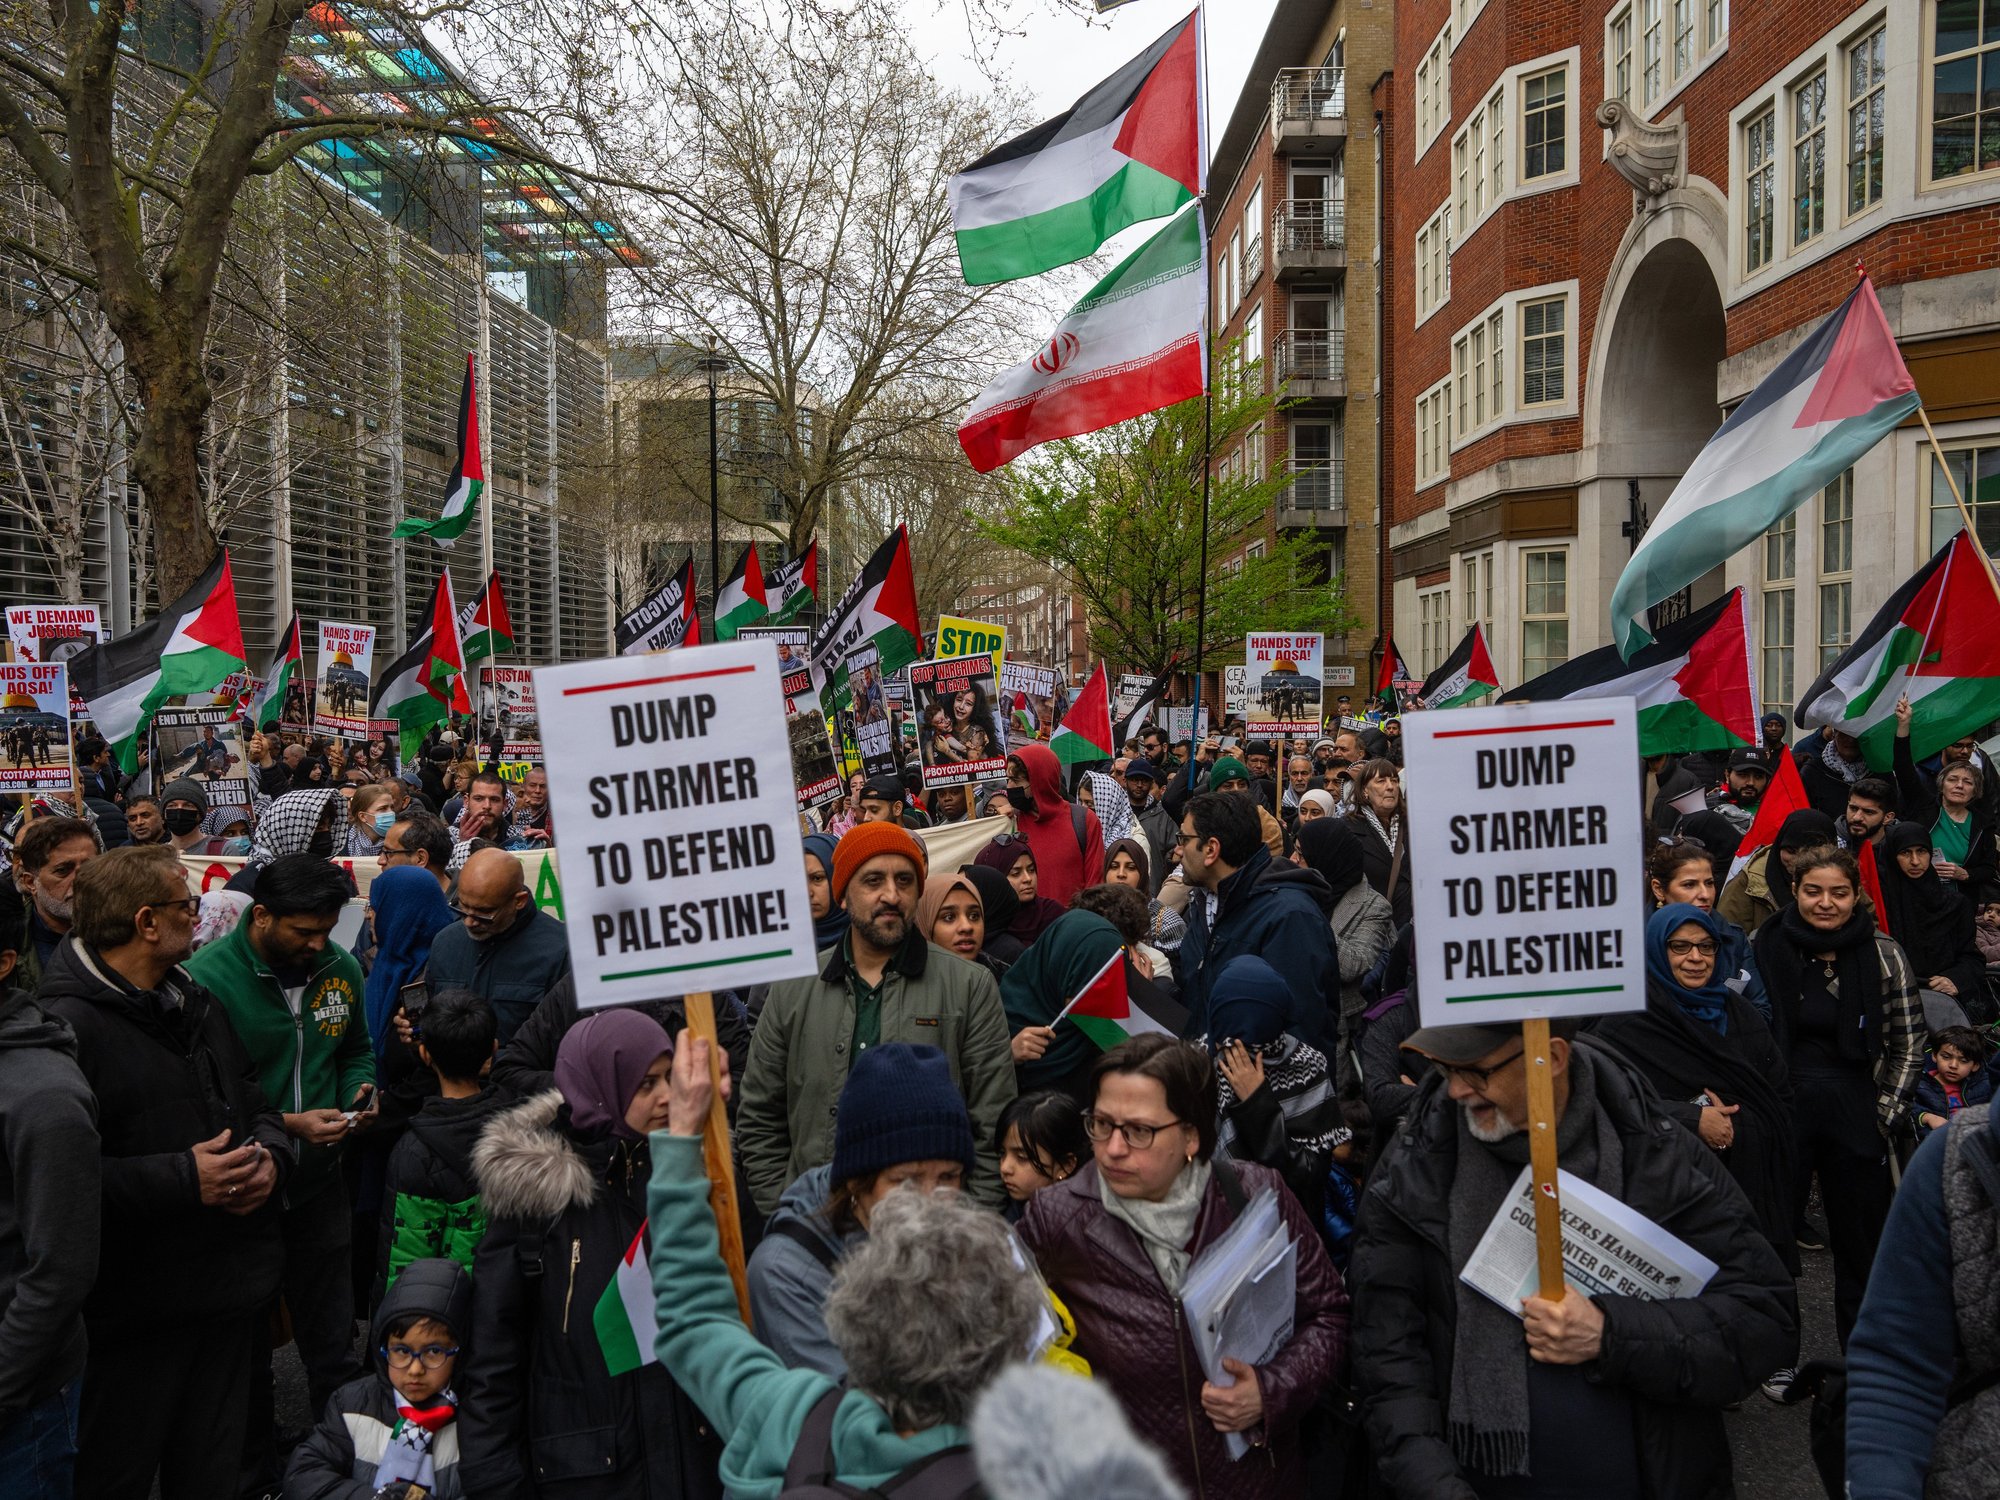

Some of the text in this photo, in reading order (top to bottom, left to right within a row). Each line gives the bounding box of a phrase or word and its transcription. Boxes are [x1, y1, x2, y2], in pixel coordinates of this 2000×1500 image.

[9, 610, 95, 624] WE DEMAND
[28, 624, 83, 638] JUSTICE
[324, 626, 371, 642] HANDS OFF
[326, 640, 364, 656] AL AQSA!
[942, 628, 1002, 658] STOP
[1251, 638, 1317, 648] HANDS OFF
[1256, 650, 1311, 661] AL AQSA!
[32, 667, 59, 679] OFF
[912, 658, 990, 684] STOP WARCRIMES
[1002, 664, 1054, 682] REEDOM FOR
[7, 681, 53, 694] AQSA!
[782, 672, 810, 696] CIDE
[936, 678, 970, 695] IN GAZA
[1000, 674, 1052, 698] ALESTINE
[1124, 676, 1153, 686] ZIONISM
[522, 686, 530, 694] By
[1124, 687, 1148, 696] RACIS
[522, 695, 536, 703] Mea
[508, 705, 536, 713] Necessa
[158, 711, 227, 726] END THE KILLIN
[610, 693, 717, 748] DUMP
[1248, 722, 1318, 732] #BOYCOTTAPARTHEID
[925, 759, 1005, 778] #BOYCOTTAPARTHEID
[1476, 744, 1576, 790] DUMP
[36, 779, 70, 788] IHRC.ORG
[926, 769, 1006, 786] INMINDS.COM IHRC.ORG
[210, 780, 245, 792] ISRAELI
[589, 757, 759, 819] STARMER
[798, 777, 838, 800] APARTHEID
[206, 791, 248, 806] THEID
[1450, 805, 1608, 854] STARMER
[587, 823, 776, 888] TO DEFEND
[1443, 868, 1618, 918] TO DEFEND
[592, 889, 790, 957] PALESTINE!
[1444, 929, 1624, 980] PALESTINE!
[326, 990, 342, 1005] 84
[330, 1016, 342, 1024] AND
[1522, 1182, 1602, 1242] WKERS
[1510, 1206, 1536, 1234] COL
[1599, 1264, 1618, 1282] OF
[1617, 1277, 1650, 1302] REAC
